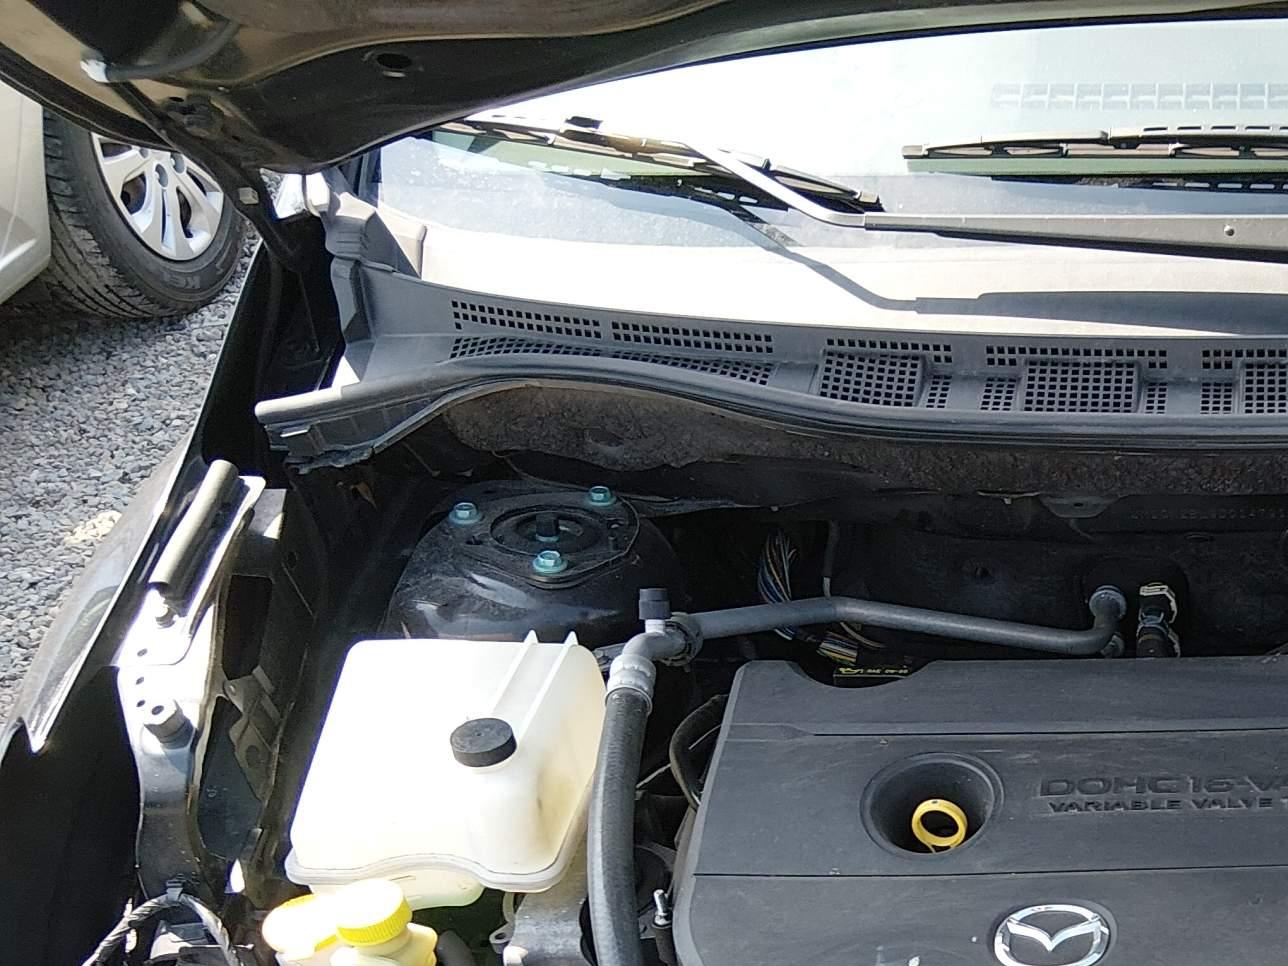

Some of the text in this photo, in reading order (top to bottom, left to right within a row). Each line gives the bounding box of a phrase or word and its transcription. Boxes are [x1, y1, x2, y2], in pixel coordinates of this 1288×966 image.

[1039, 776, 1184, 796] DOHC
[1048, 799, 1183, 814] VARIABLE
[1190, 796, 1274, 811] VALVE
